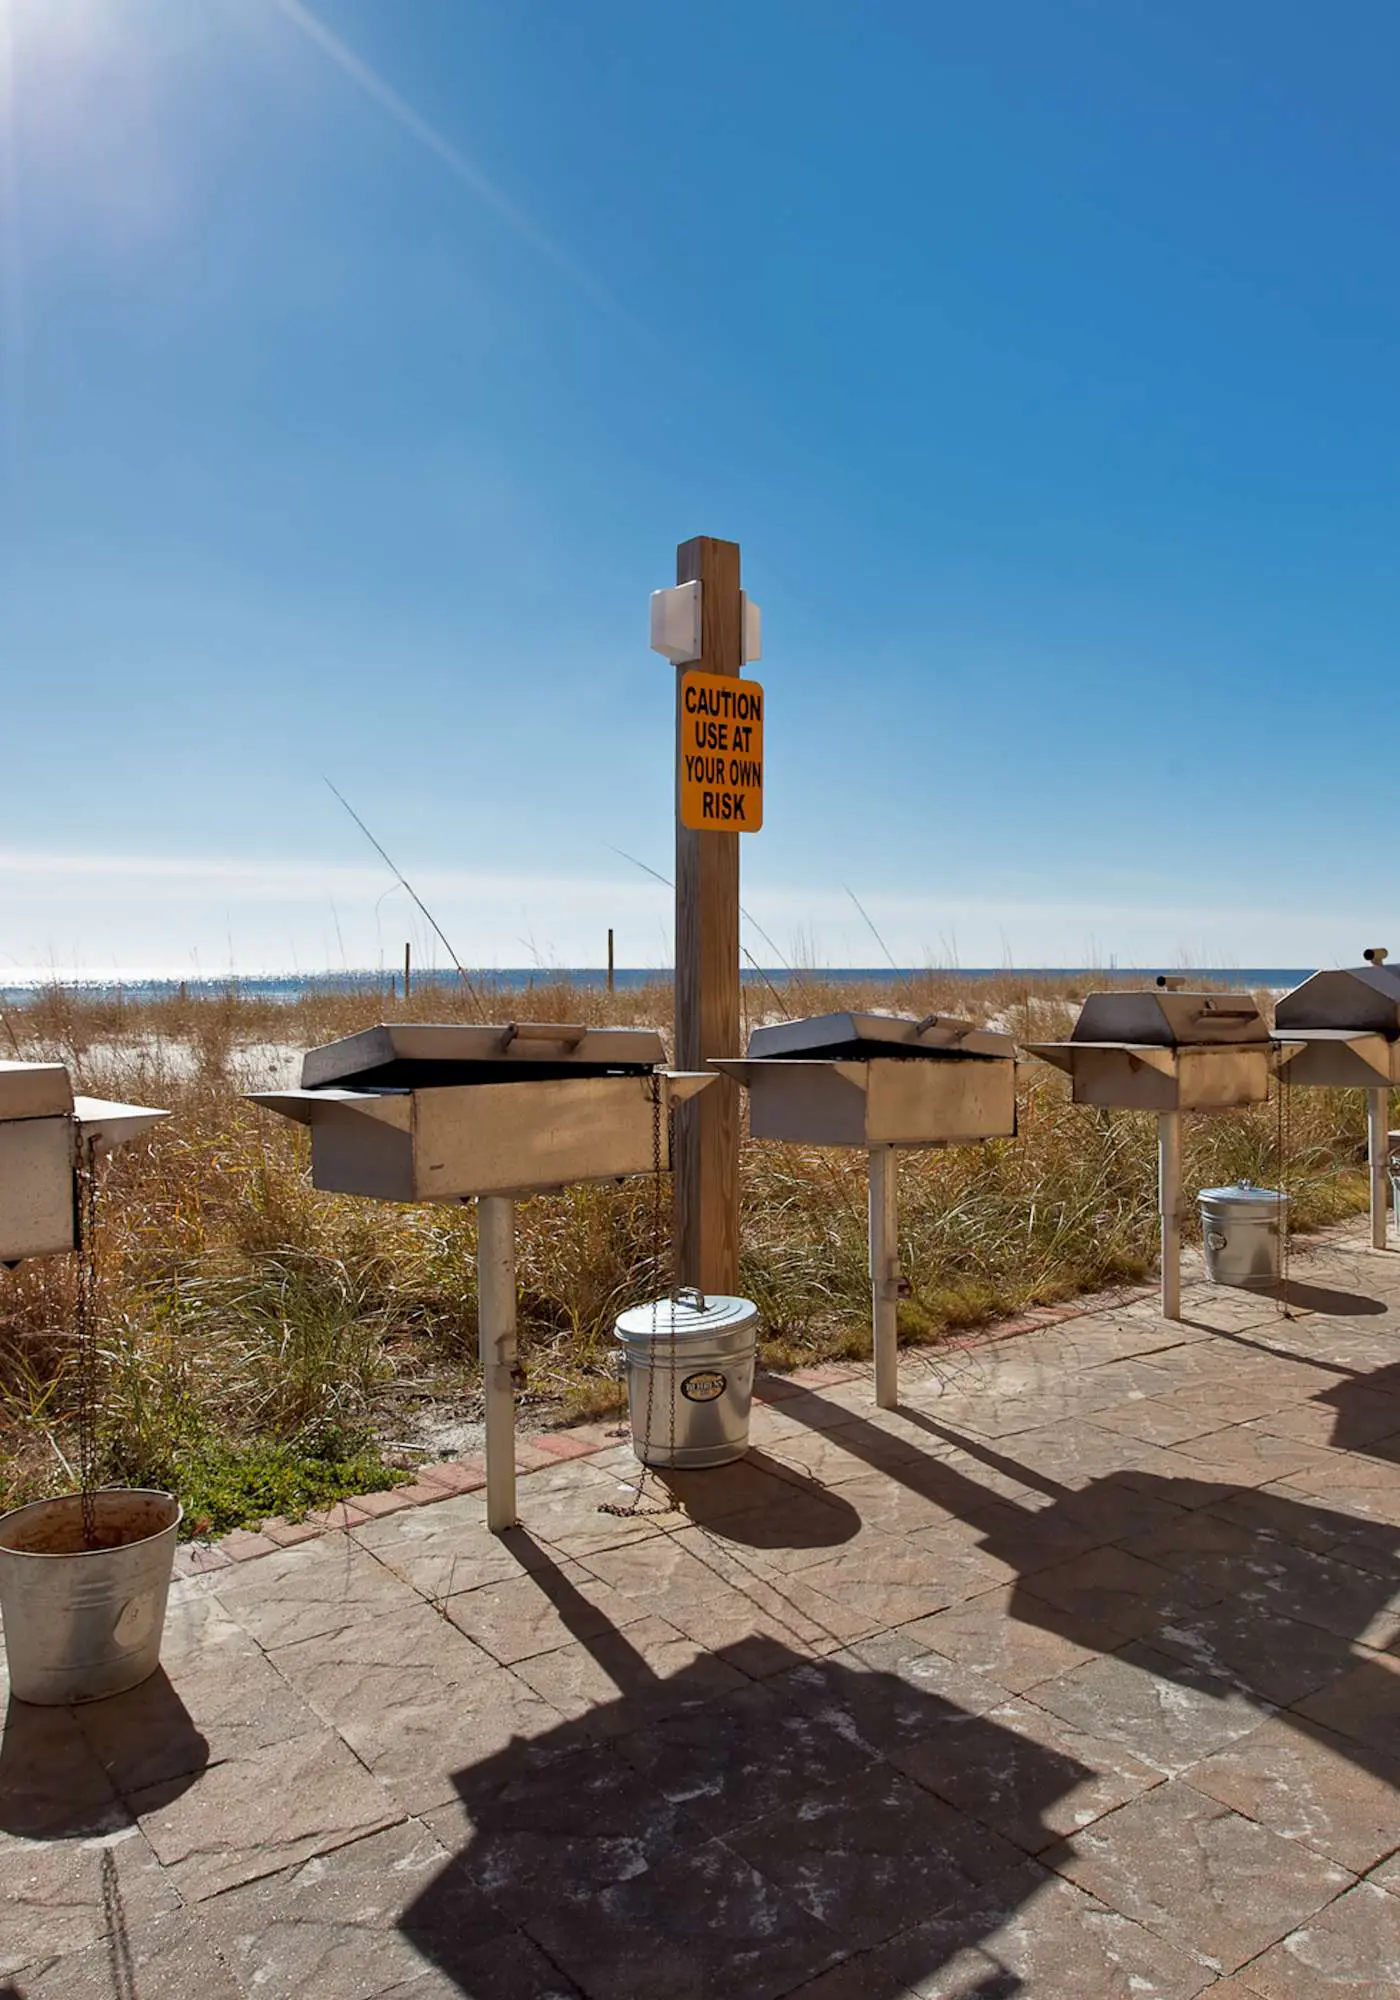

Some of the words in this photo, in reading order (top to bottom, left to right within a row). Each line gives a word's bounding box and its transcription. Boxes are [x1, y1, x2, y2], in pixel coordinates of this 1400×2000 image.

[685, 686, 761, 721] CAUTION
[695, 721, 728, 750] USE
[732, 726, 752, 752] AT
[685, 755, 725, 784] YOUR
[729, 760, 761, 788] OWN
[703, 792, 746, 820] RISK
